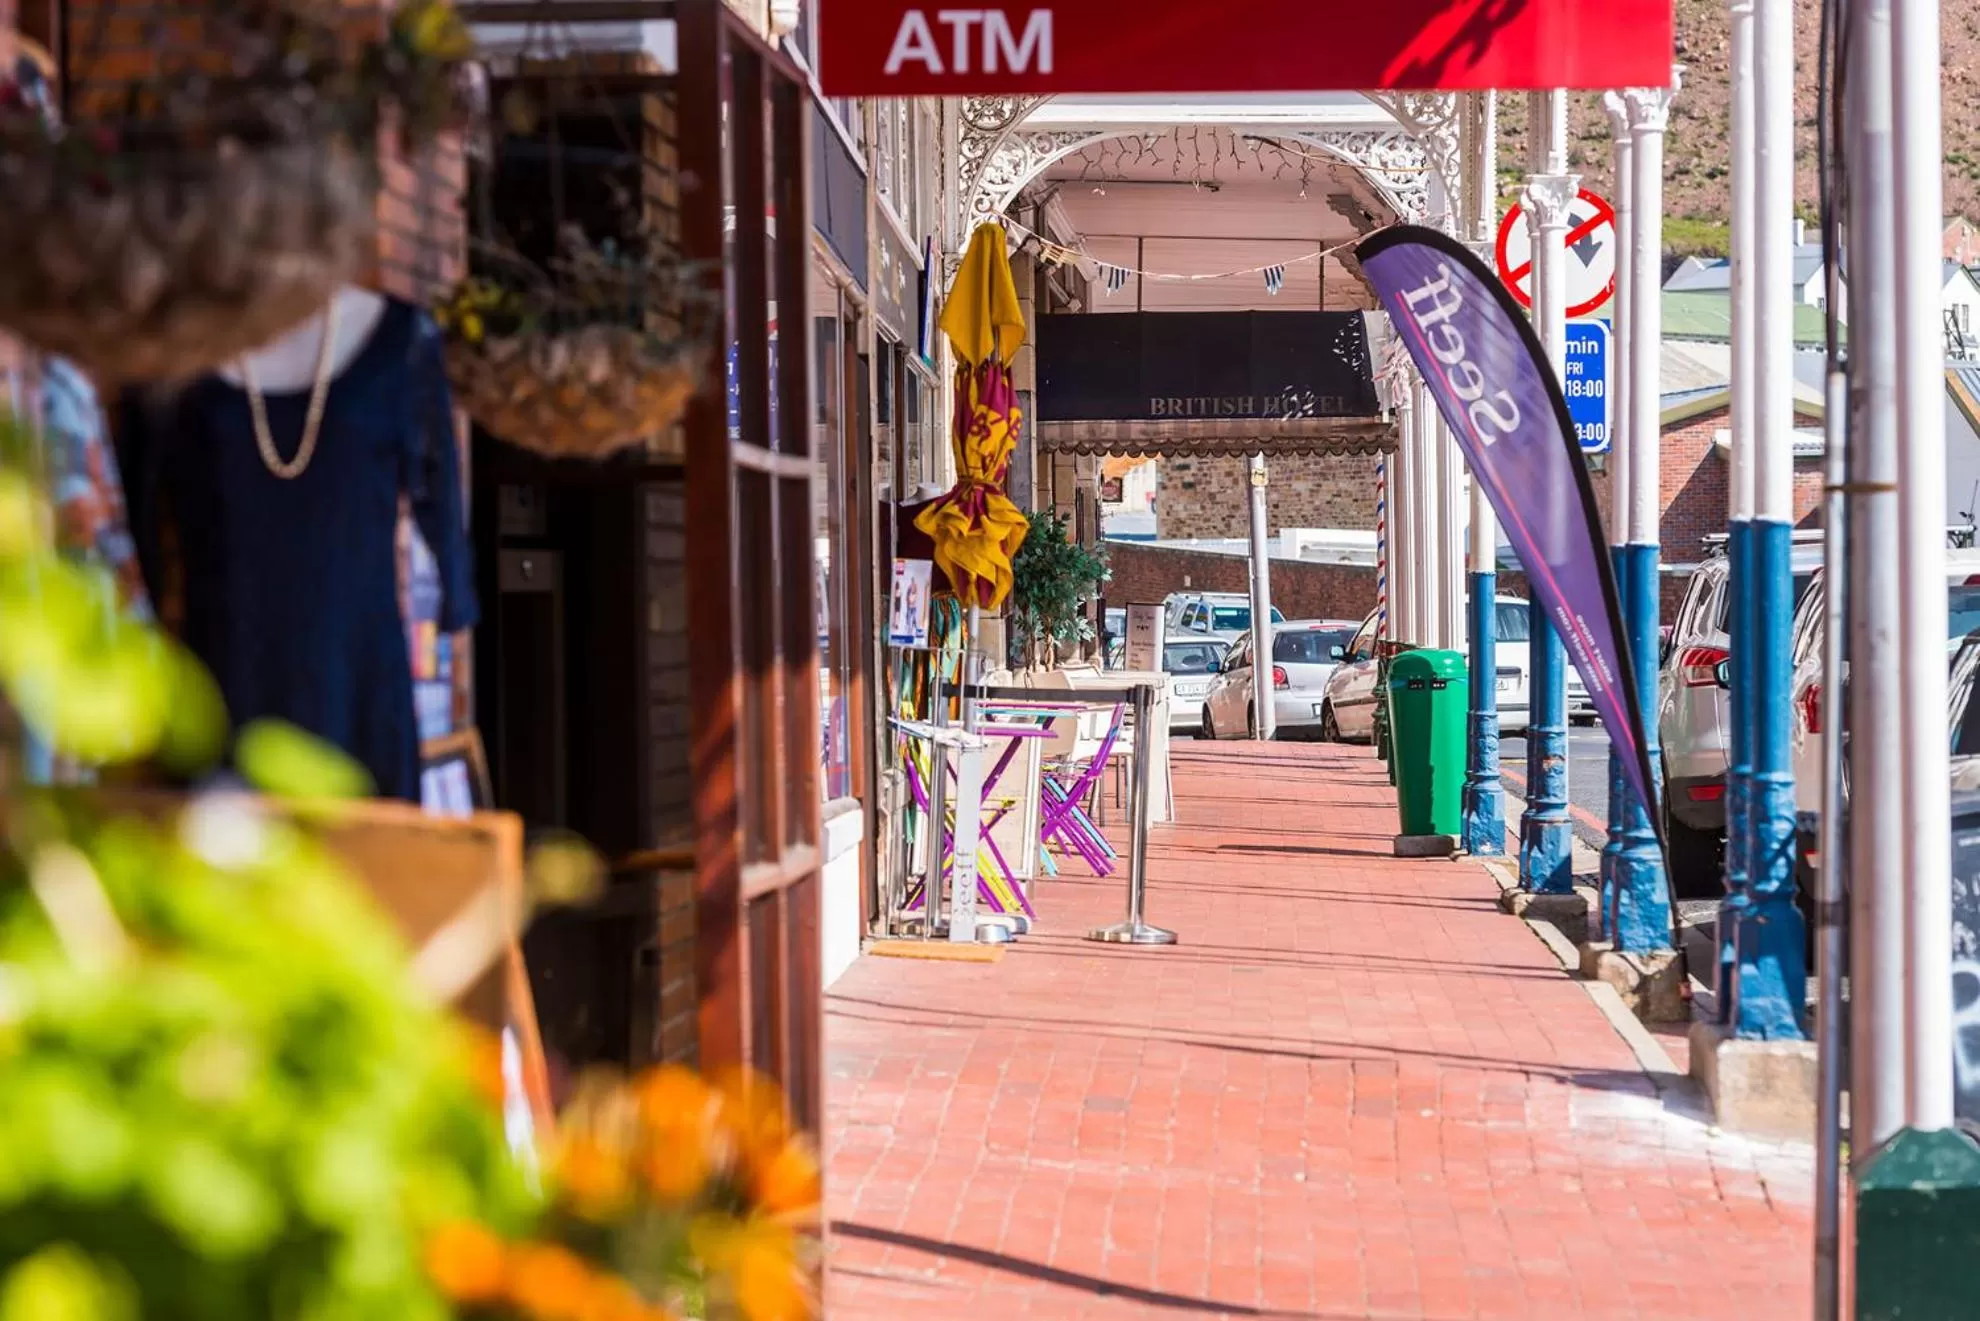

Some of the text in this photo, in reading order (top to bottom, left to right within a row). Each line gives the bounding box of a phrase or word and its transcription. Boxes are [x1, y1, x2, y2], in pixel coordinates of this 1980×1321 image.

[883, 8, 1054, 75] ATM
[1566, 335, 1599, 354] min
[1566, 361, 1584, 375] FRI
[1566, 379, 1604, 397] 18:00
[1150, 397, 1255, 416] BRITISH
